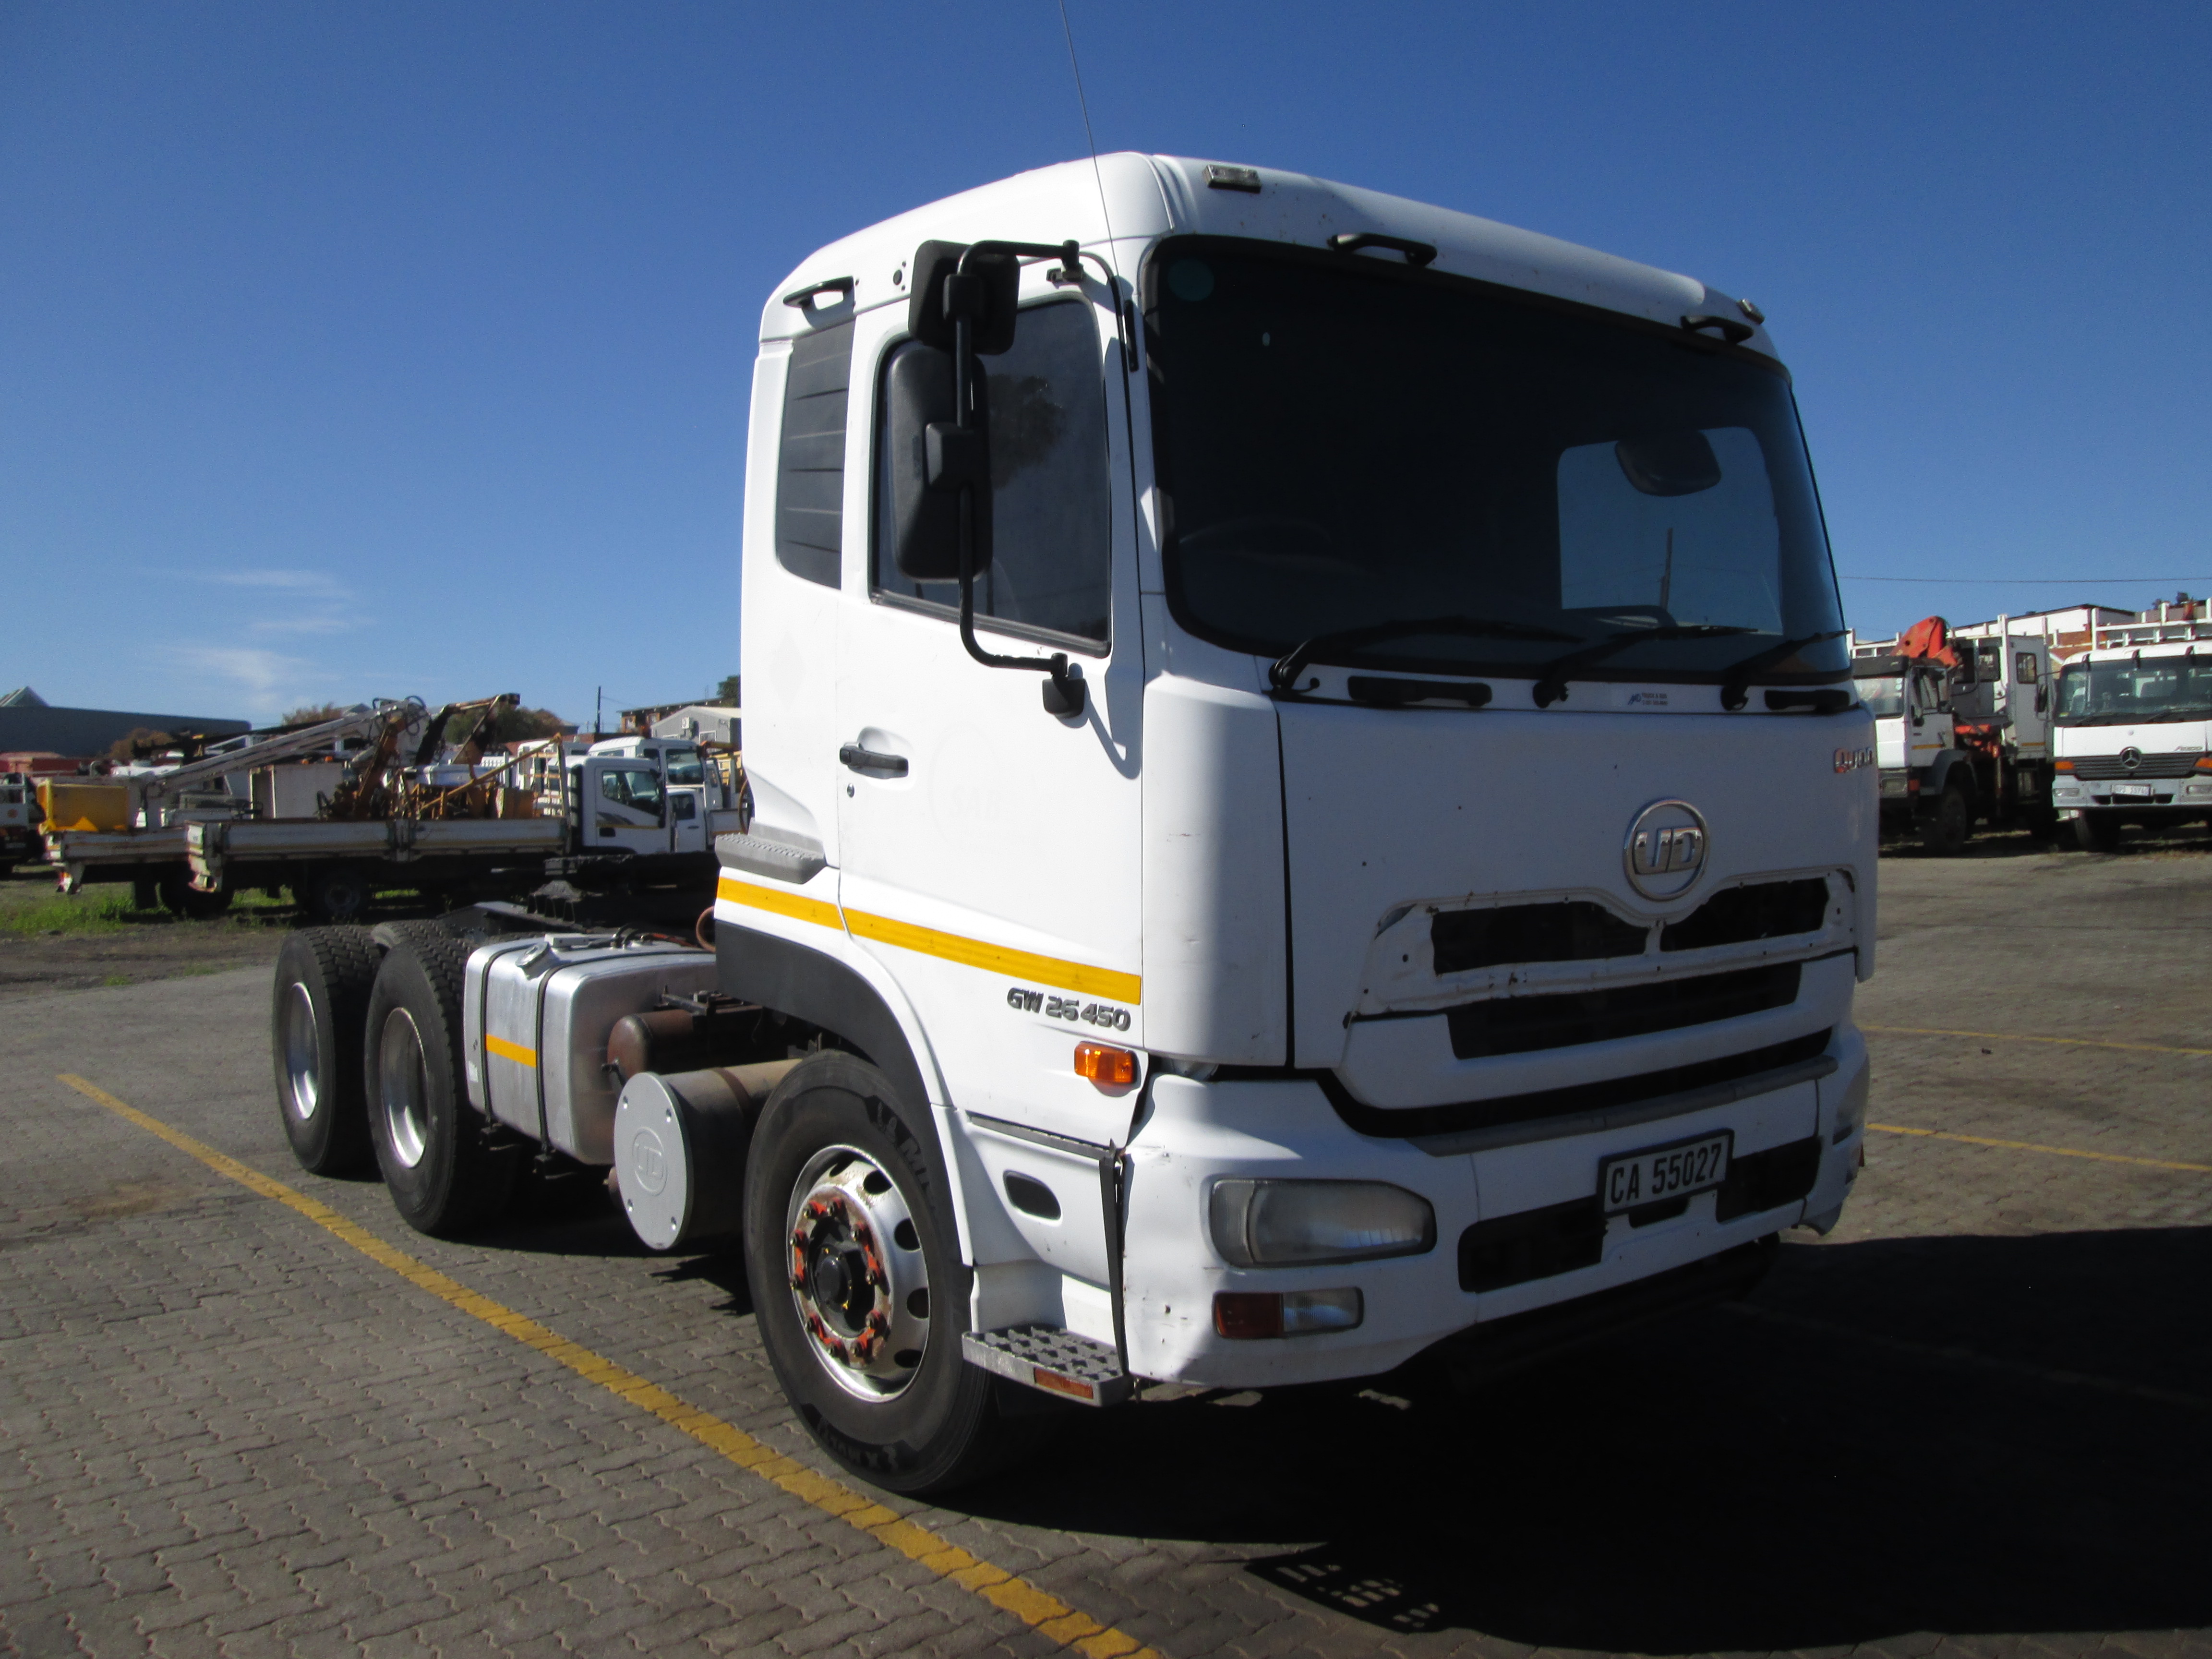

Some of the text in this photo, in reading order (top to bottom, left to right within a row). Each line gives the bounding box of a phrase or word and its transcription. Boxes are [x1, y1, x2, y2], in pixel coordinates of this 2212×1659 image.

[1633, 827, 1704, 875] UD
[1007, 987, 1131, 1032] GW 26 450
[1611, 1142, 1722, 1204] CA 55027
